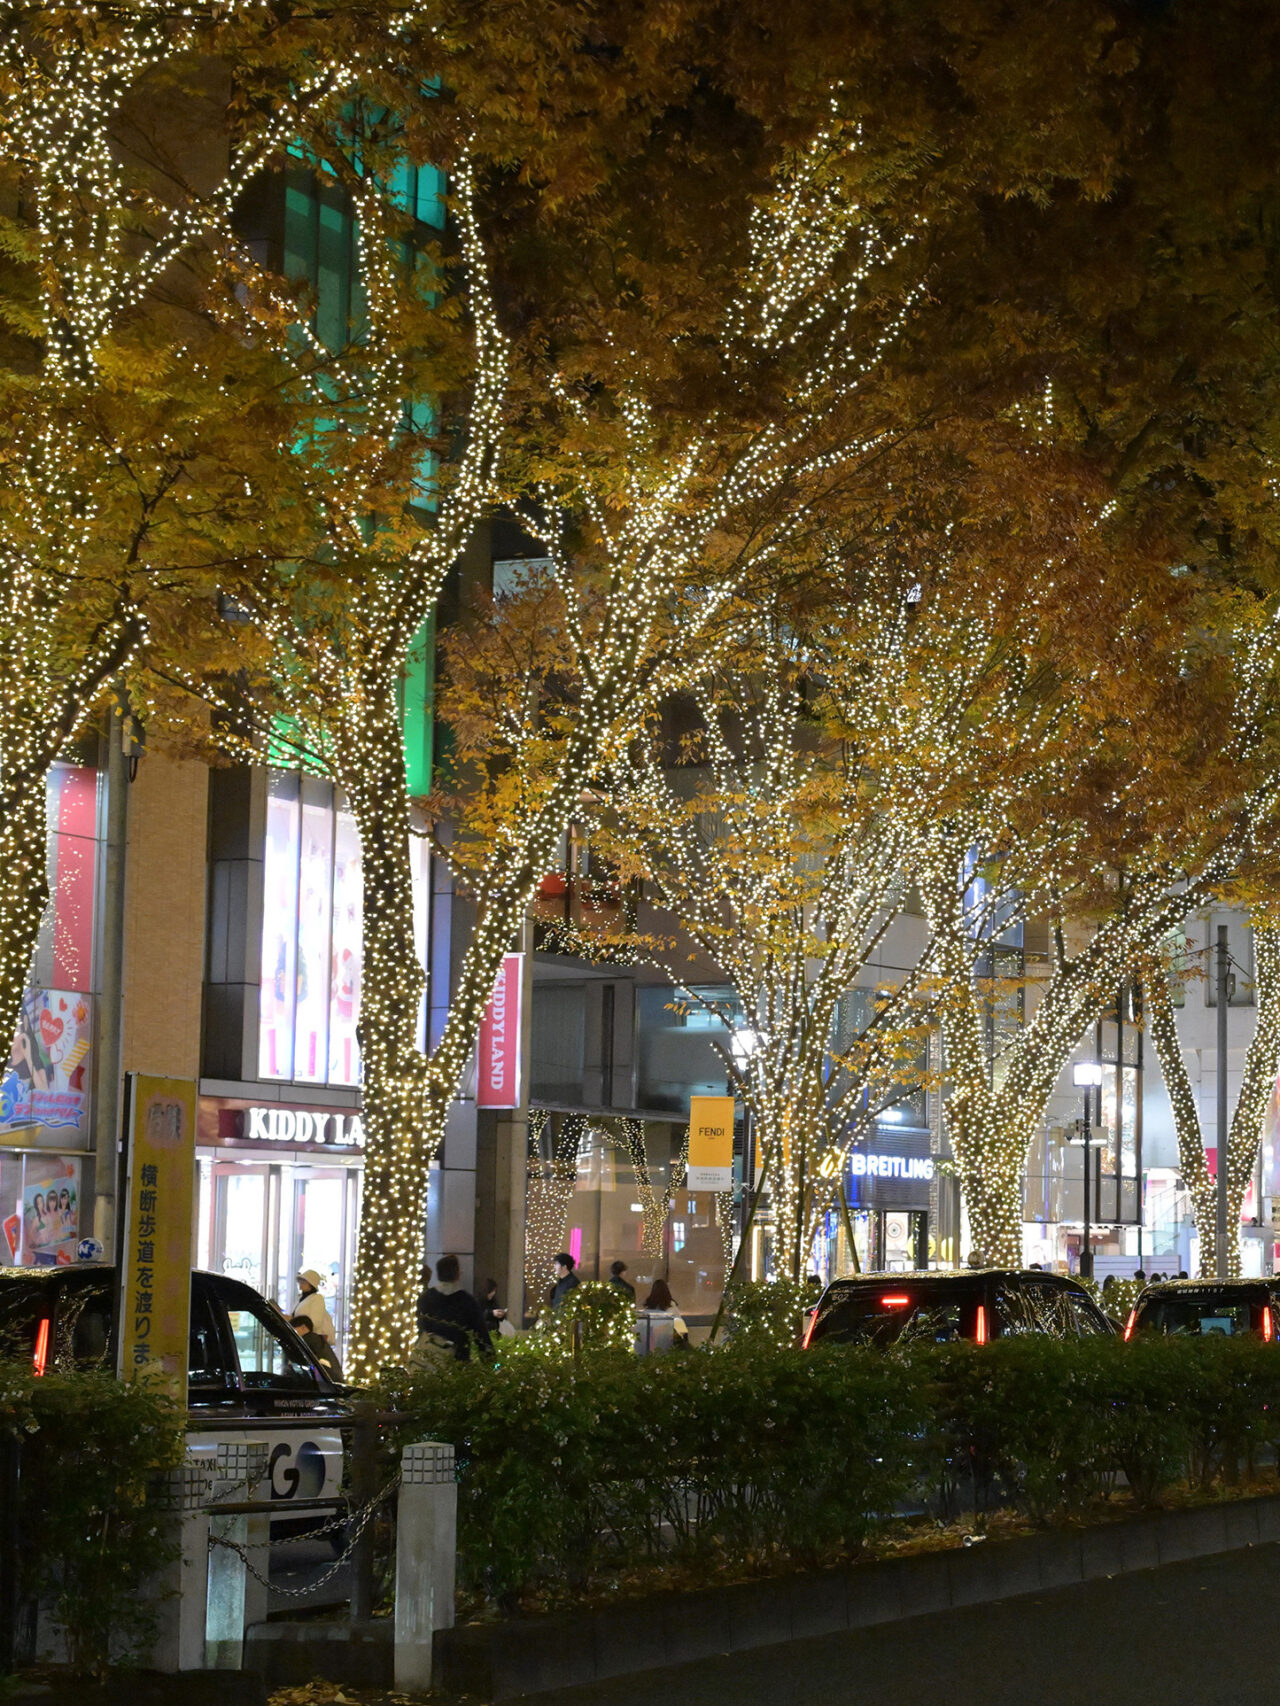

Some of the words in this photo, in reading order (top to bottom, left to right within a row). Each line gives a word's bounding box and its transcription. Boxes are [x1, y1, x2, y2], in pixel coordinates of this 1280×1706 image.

[249, 1108, 329, 1142] KIDDY
[333, 1113, 365, 1147] LA
[698, 1127, 725, 1136] FENDI
[851, 1153, 934, 1179] BREITLING
[269, 1441, 326, 1500] GO
